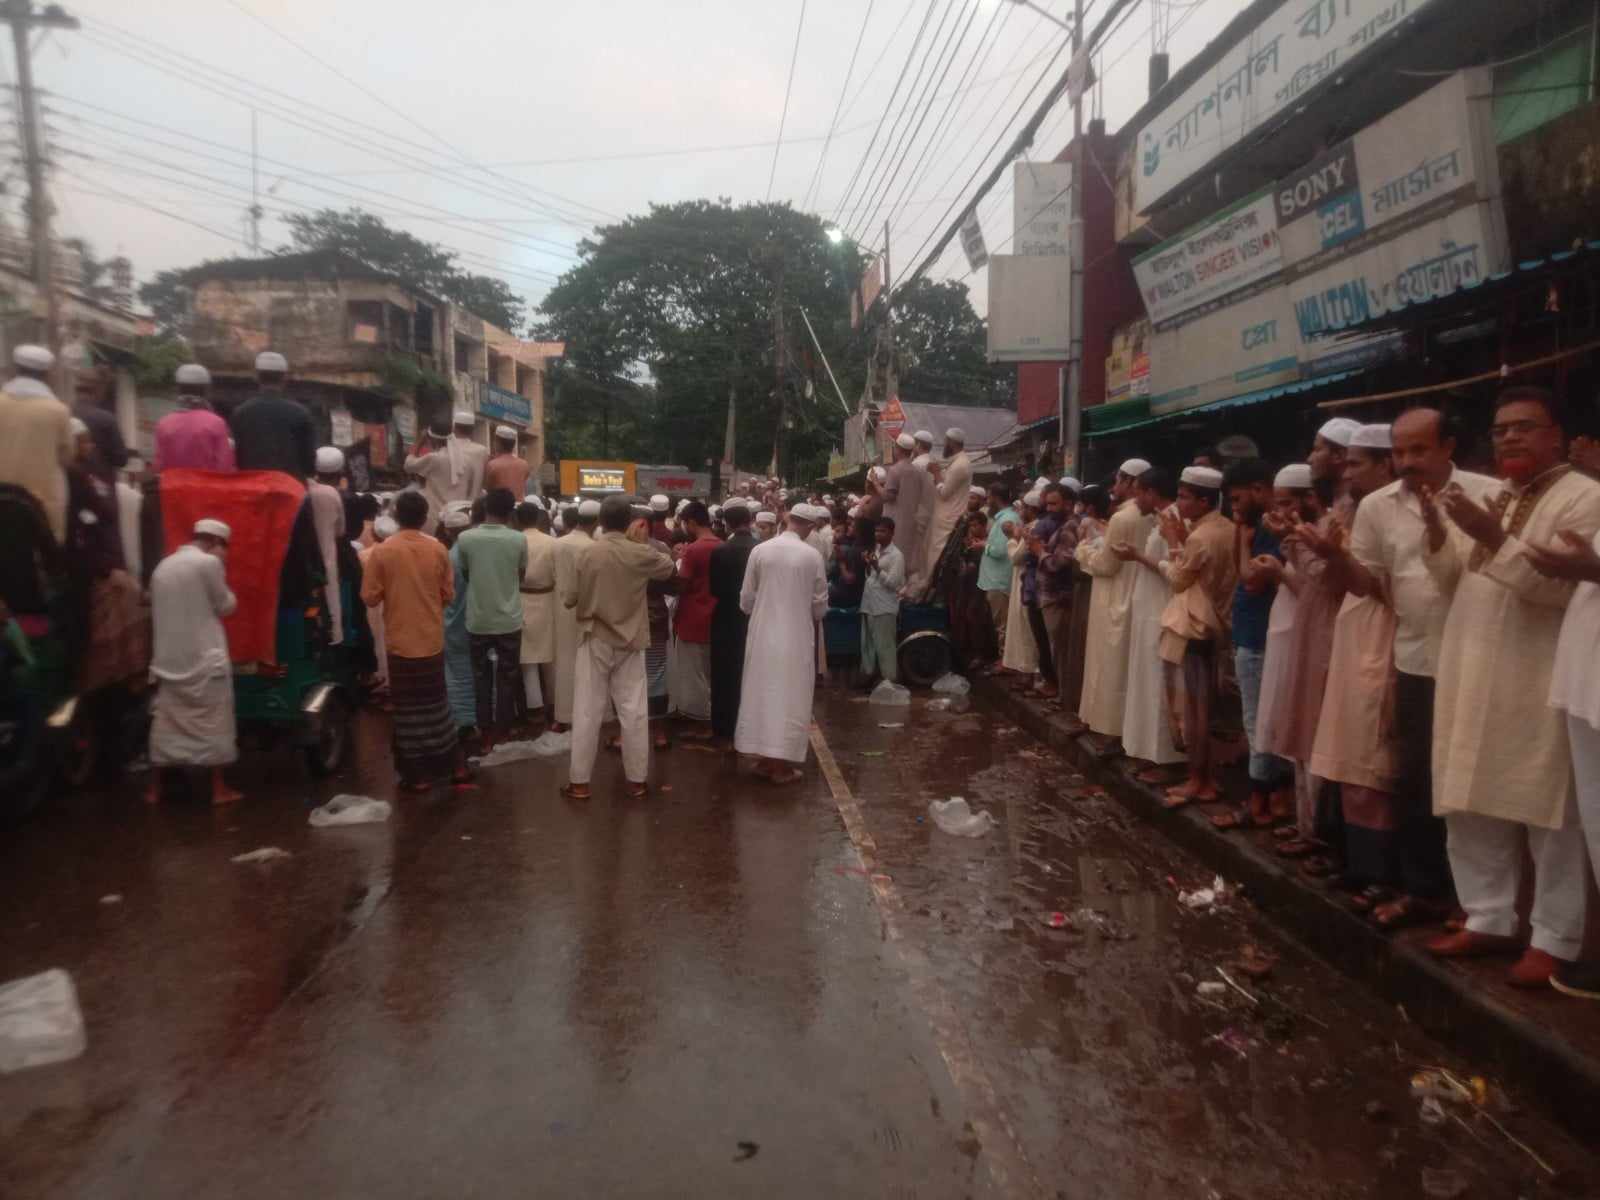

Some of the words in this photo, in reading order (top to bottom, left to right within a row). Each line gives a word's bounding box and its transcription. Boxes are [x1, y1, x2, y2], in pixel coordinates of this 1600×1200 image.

[1165, 33, 1285, 150] ন্যাশনাল
[1279, 157, 1347, 217] SONY
[1296, 276, 1370, 333] WALTON
